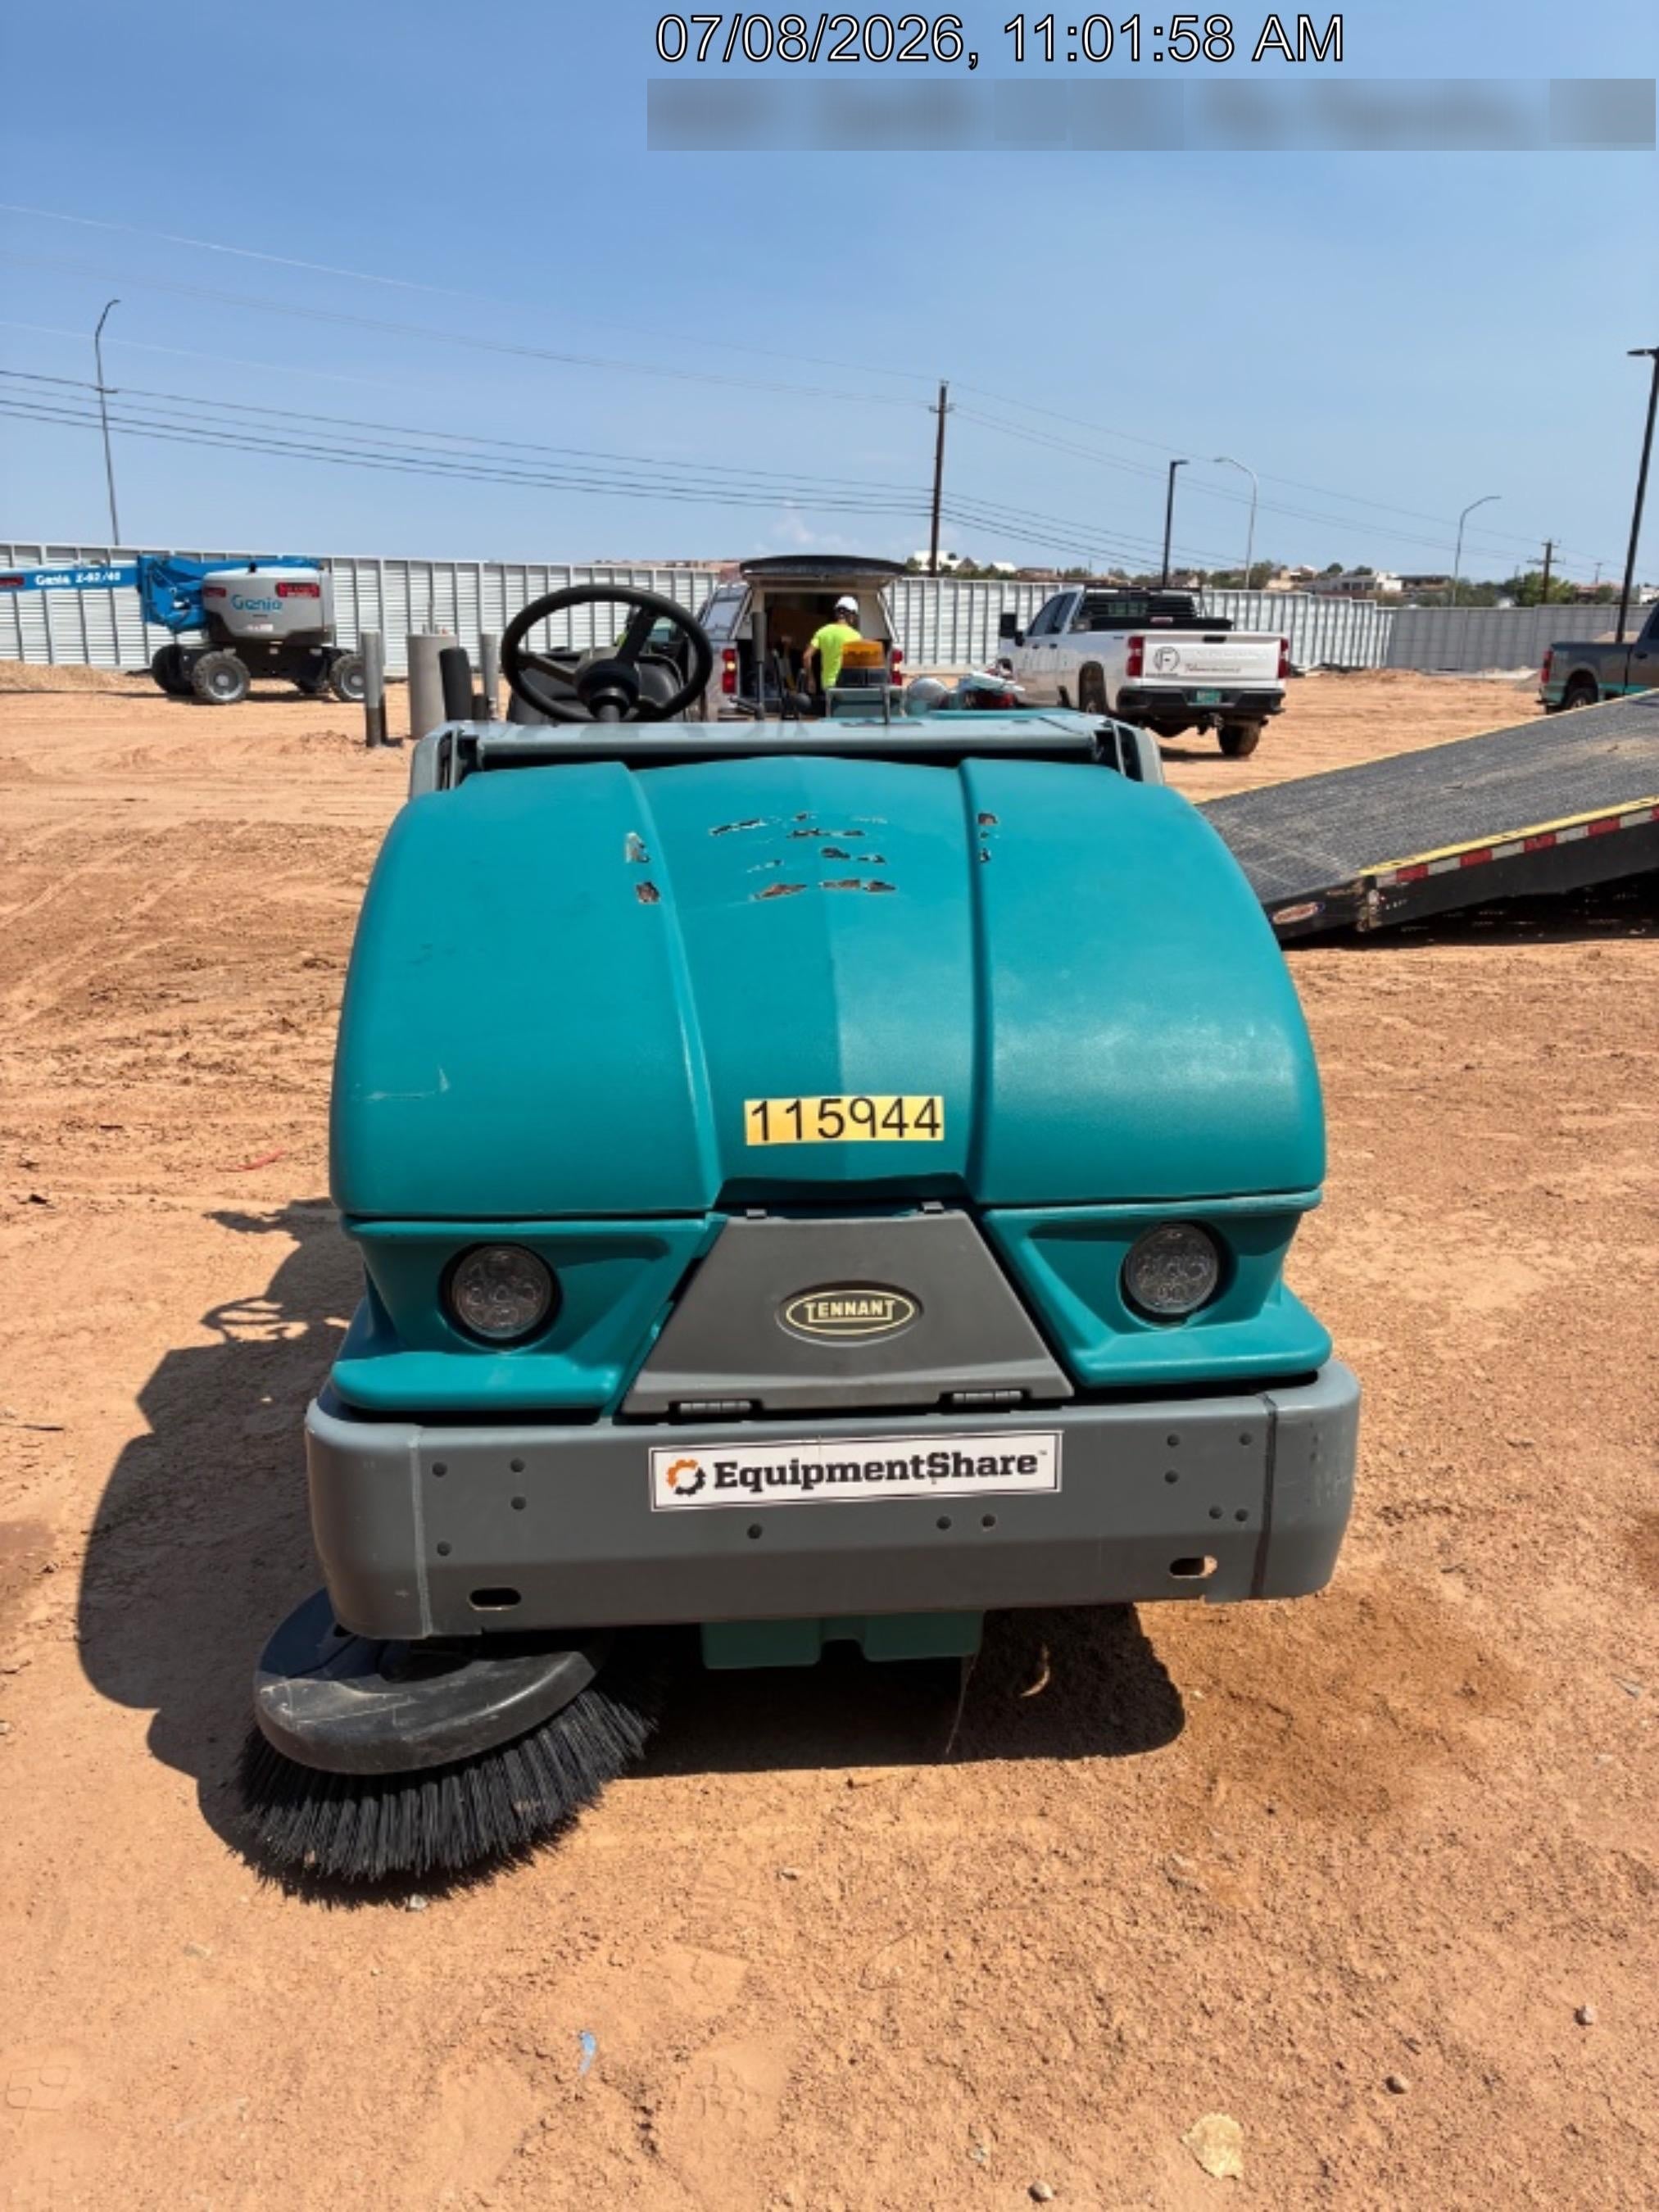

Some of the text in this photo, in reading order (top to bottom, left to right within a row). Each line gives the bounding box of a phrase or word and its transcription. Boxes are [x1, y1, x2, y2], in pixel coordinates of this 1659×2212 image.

[231, 594, 283, 610] Genie
[750, 1097, 941, 1141] 115944
[804, 1299, 895, 1323] TENNANT
[713, 1451, 1038, 1493] EquipmentShare
